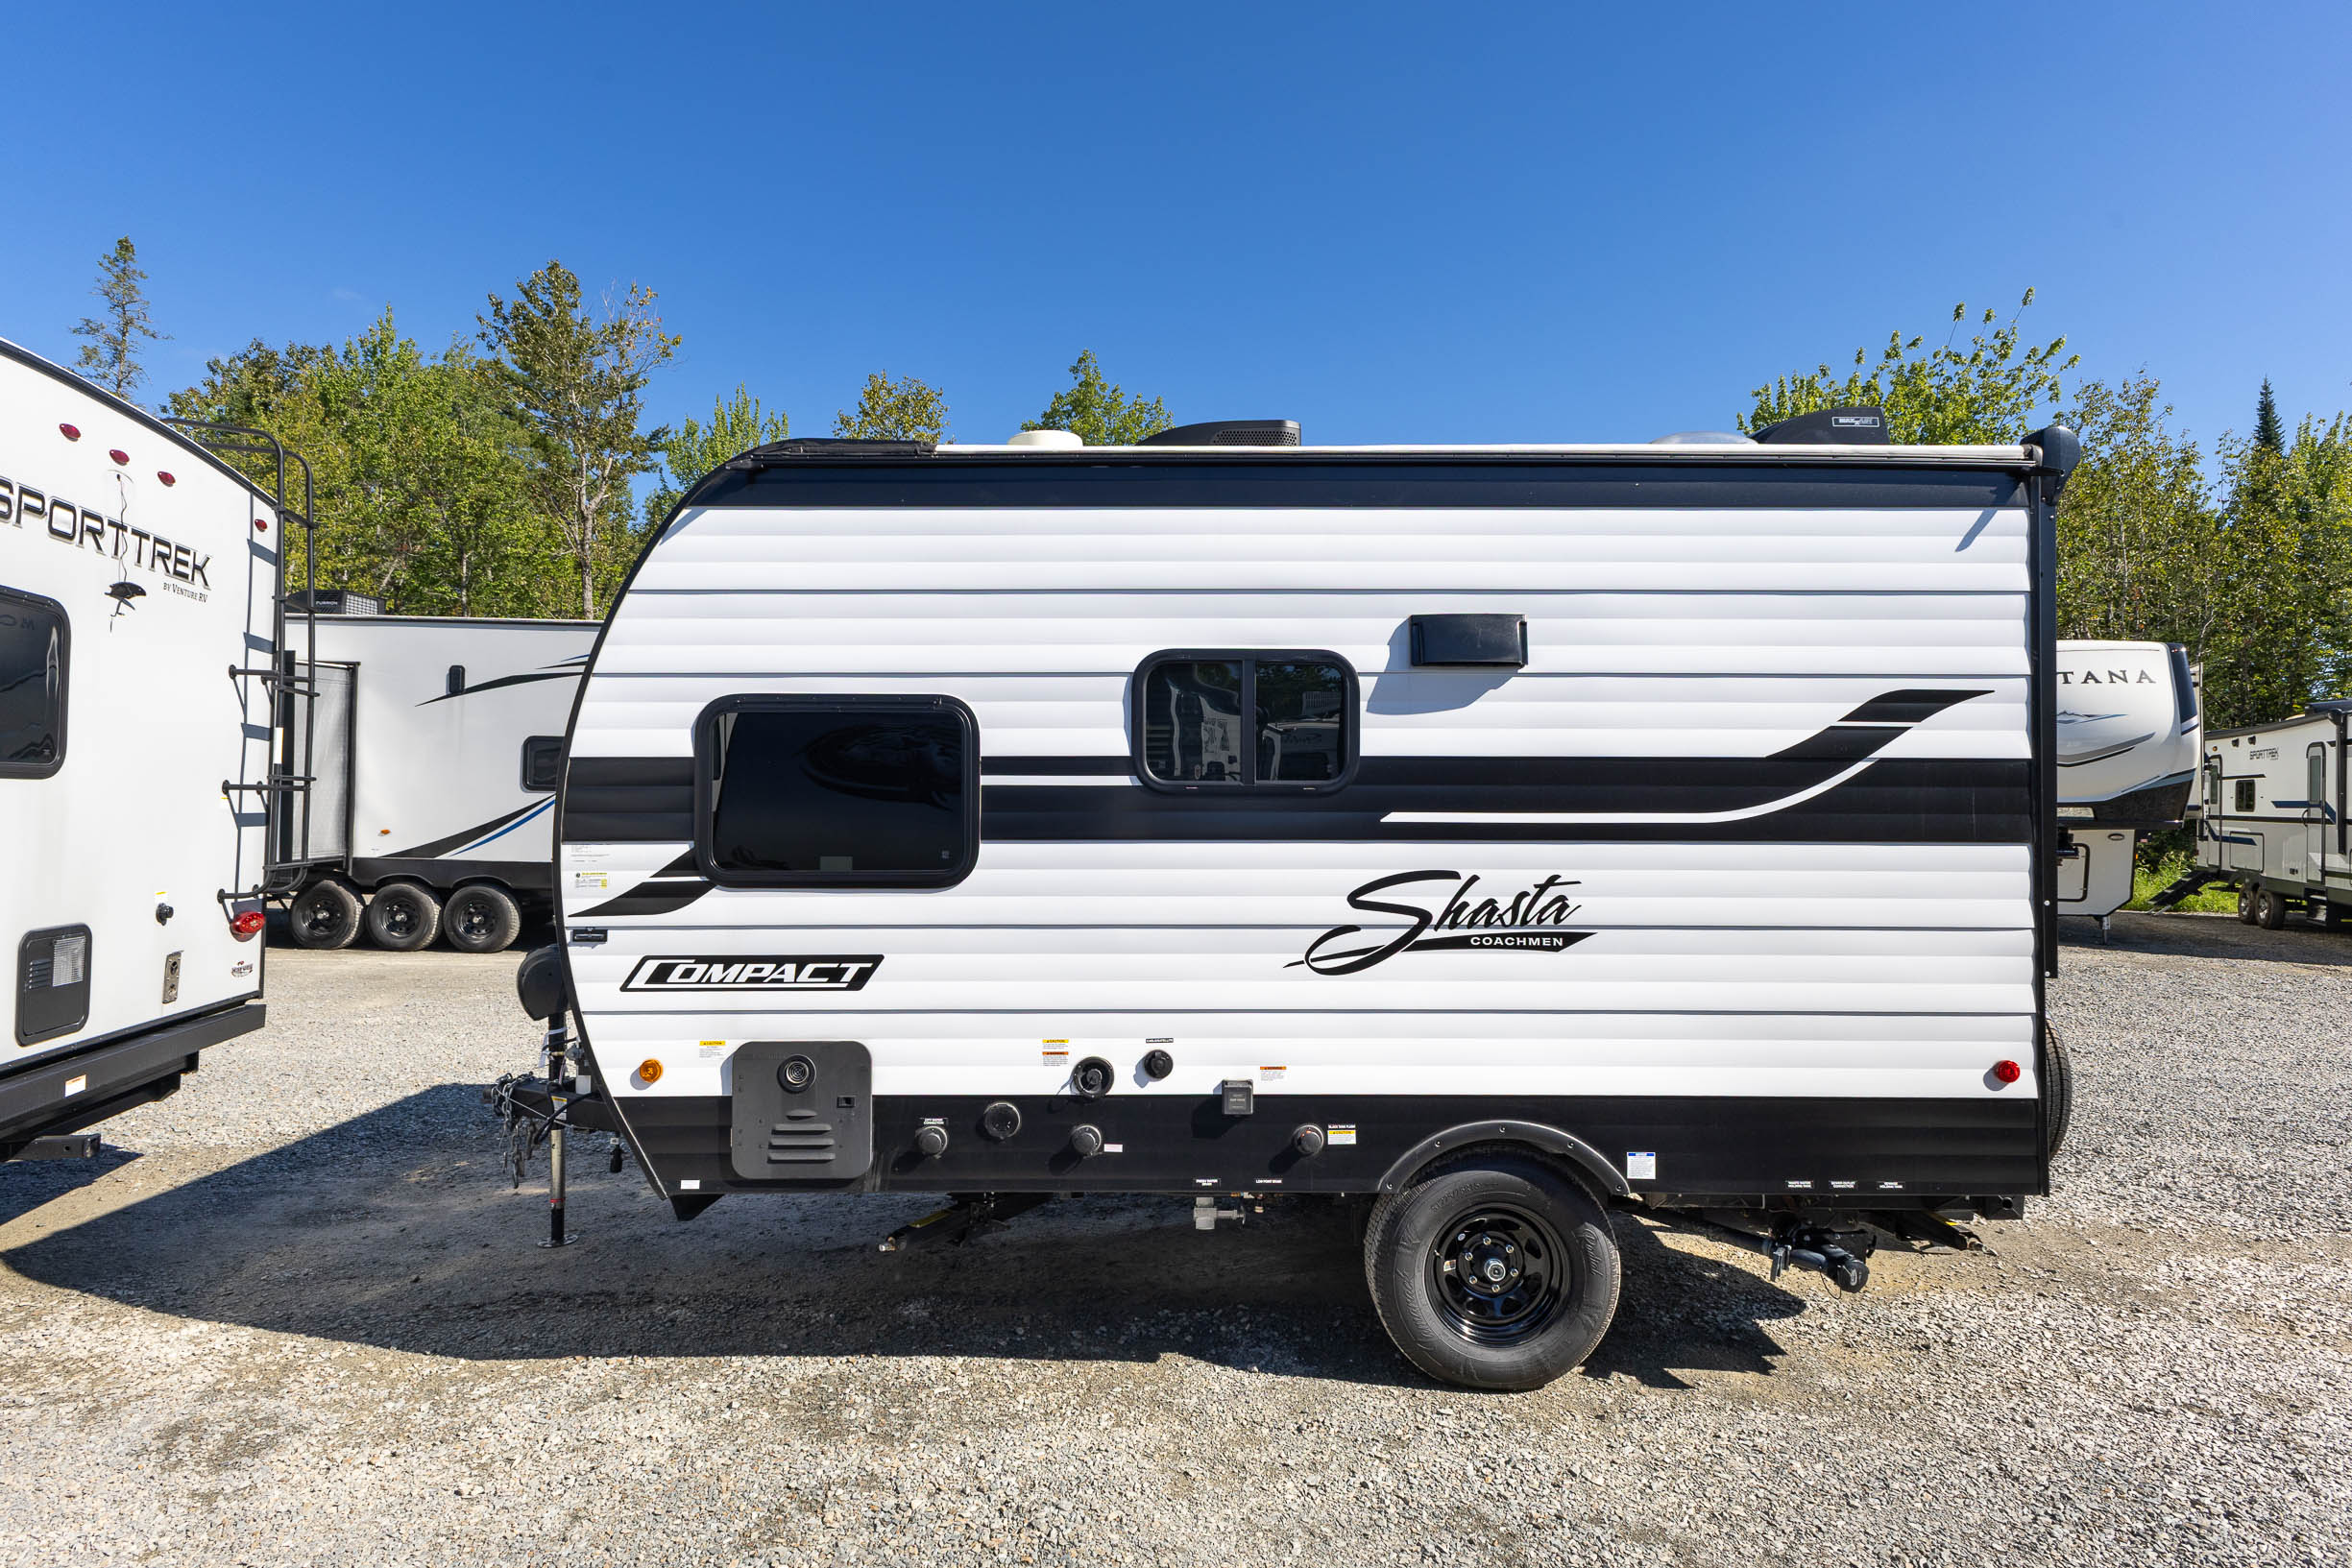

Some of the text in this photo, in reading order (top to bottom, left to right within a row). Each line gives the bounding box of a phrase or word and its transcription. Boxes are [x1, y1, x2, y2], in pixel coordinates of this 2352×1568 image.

[1304, 869, 1583, 977] Shasta
[1470, 936, 1564, 947] COACHMEN
[626, 958, 874, 989] COMPACT
